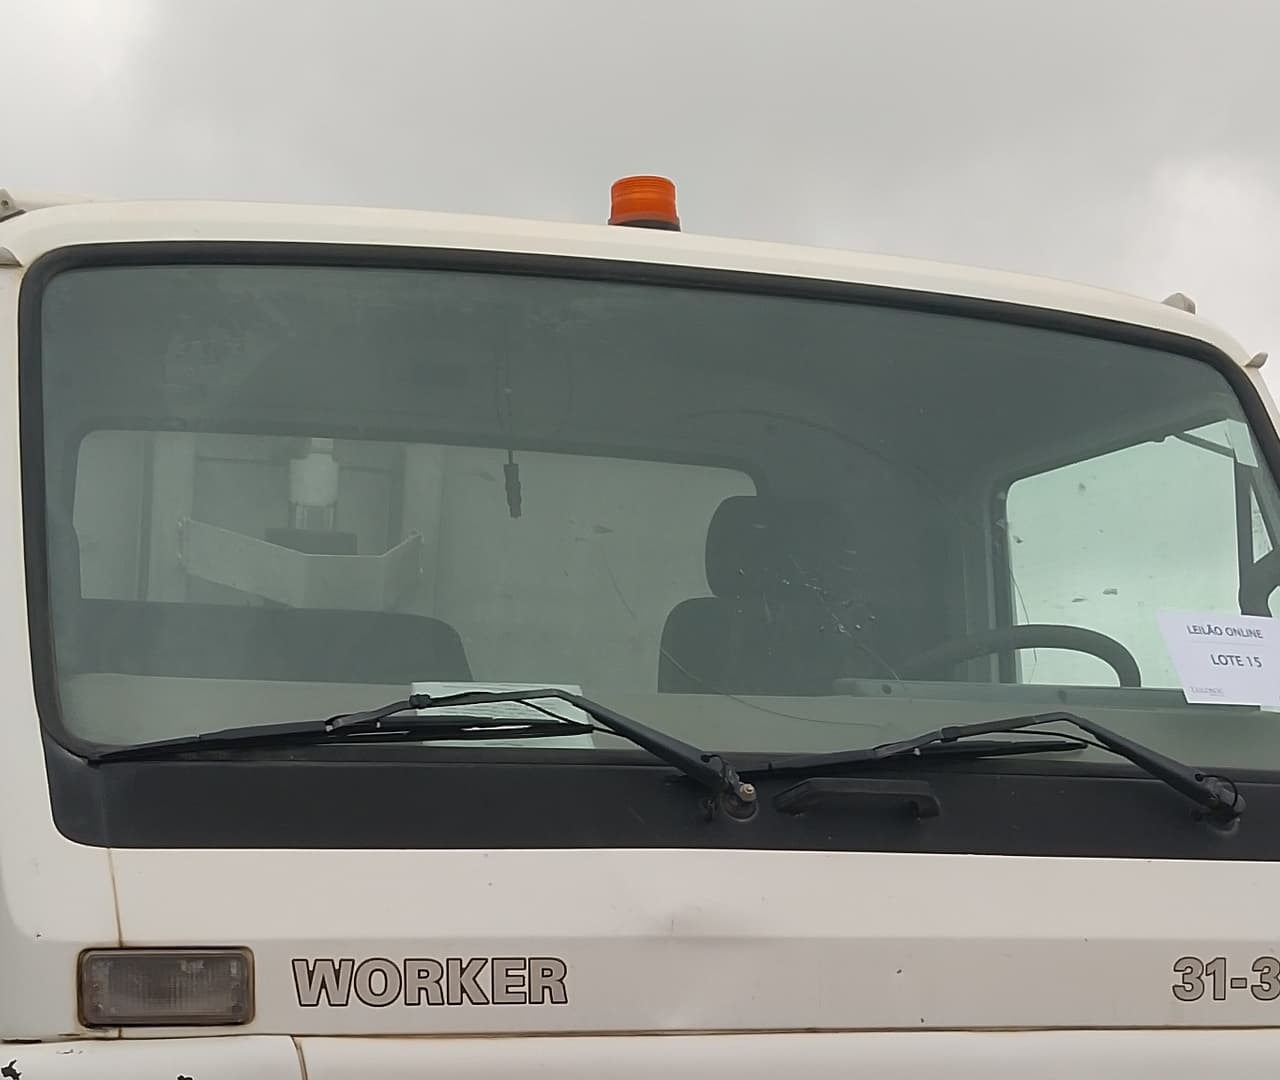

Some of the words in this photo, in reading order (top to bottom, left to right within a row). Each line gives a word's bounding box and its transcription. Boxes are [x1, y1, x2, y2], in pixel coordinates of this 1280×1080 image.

[1224, 626, 1264, 639] ONLINE
[1210, 653, 1244, 667] LOTE
[1246, 656, 1263, 668] 15
[291, 957, 568, 1008] WORKER
